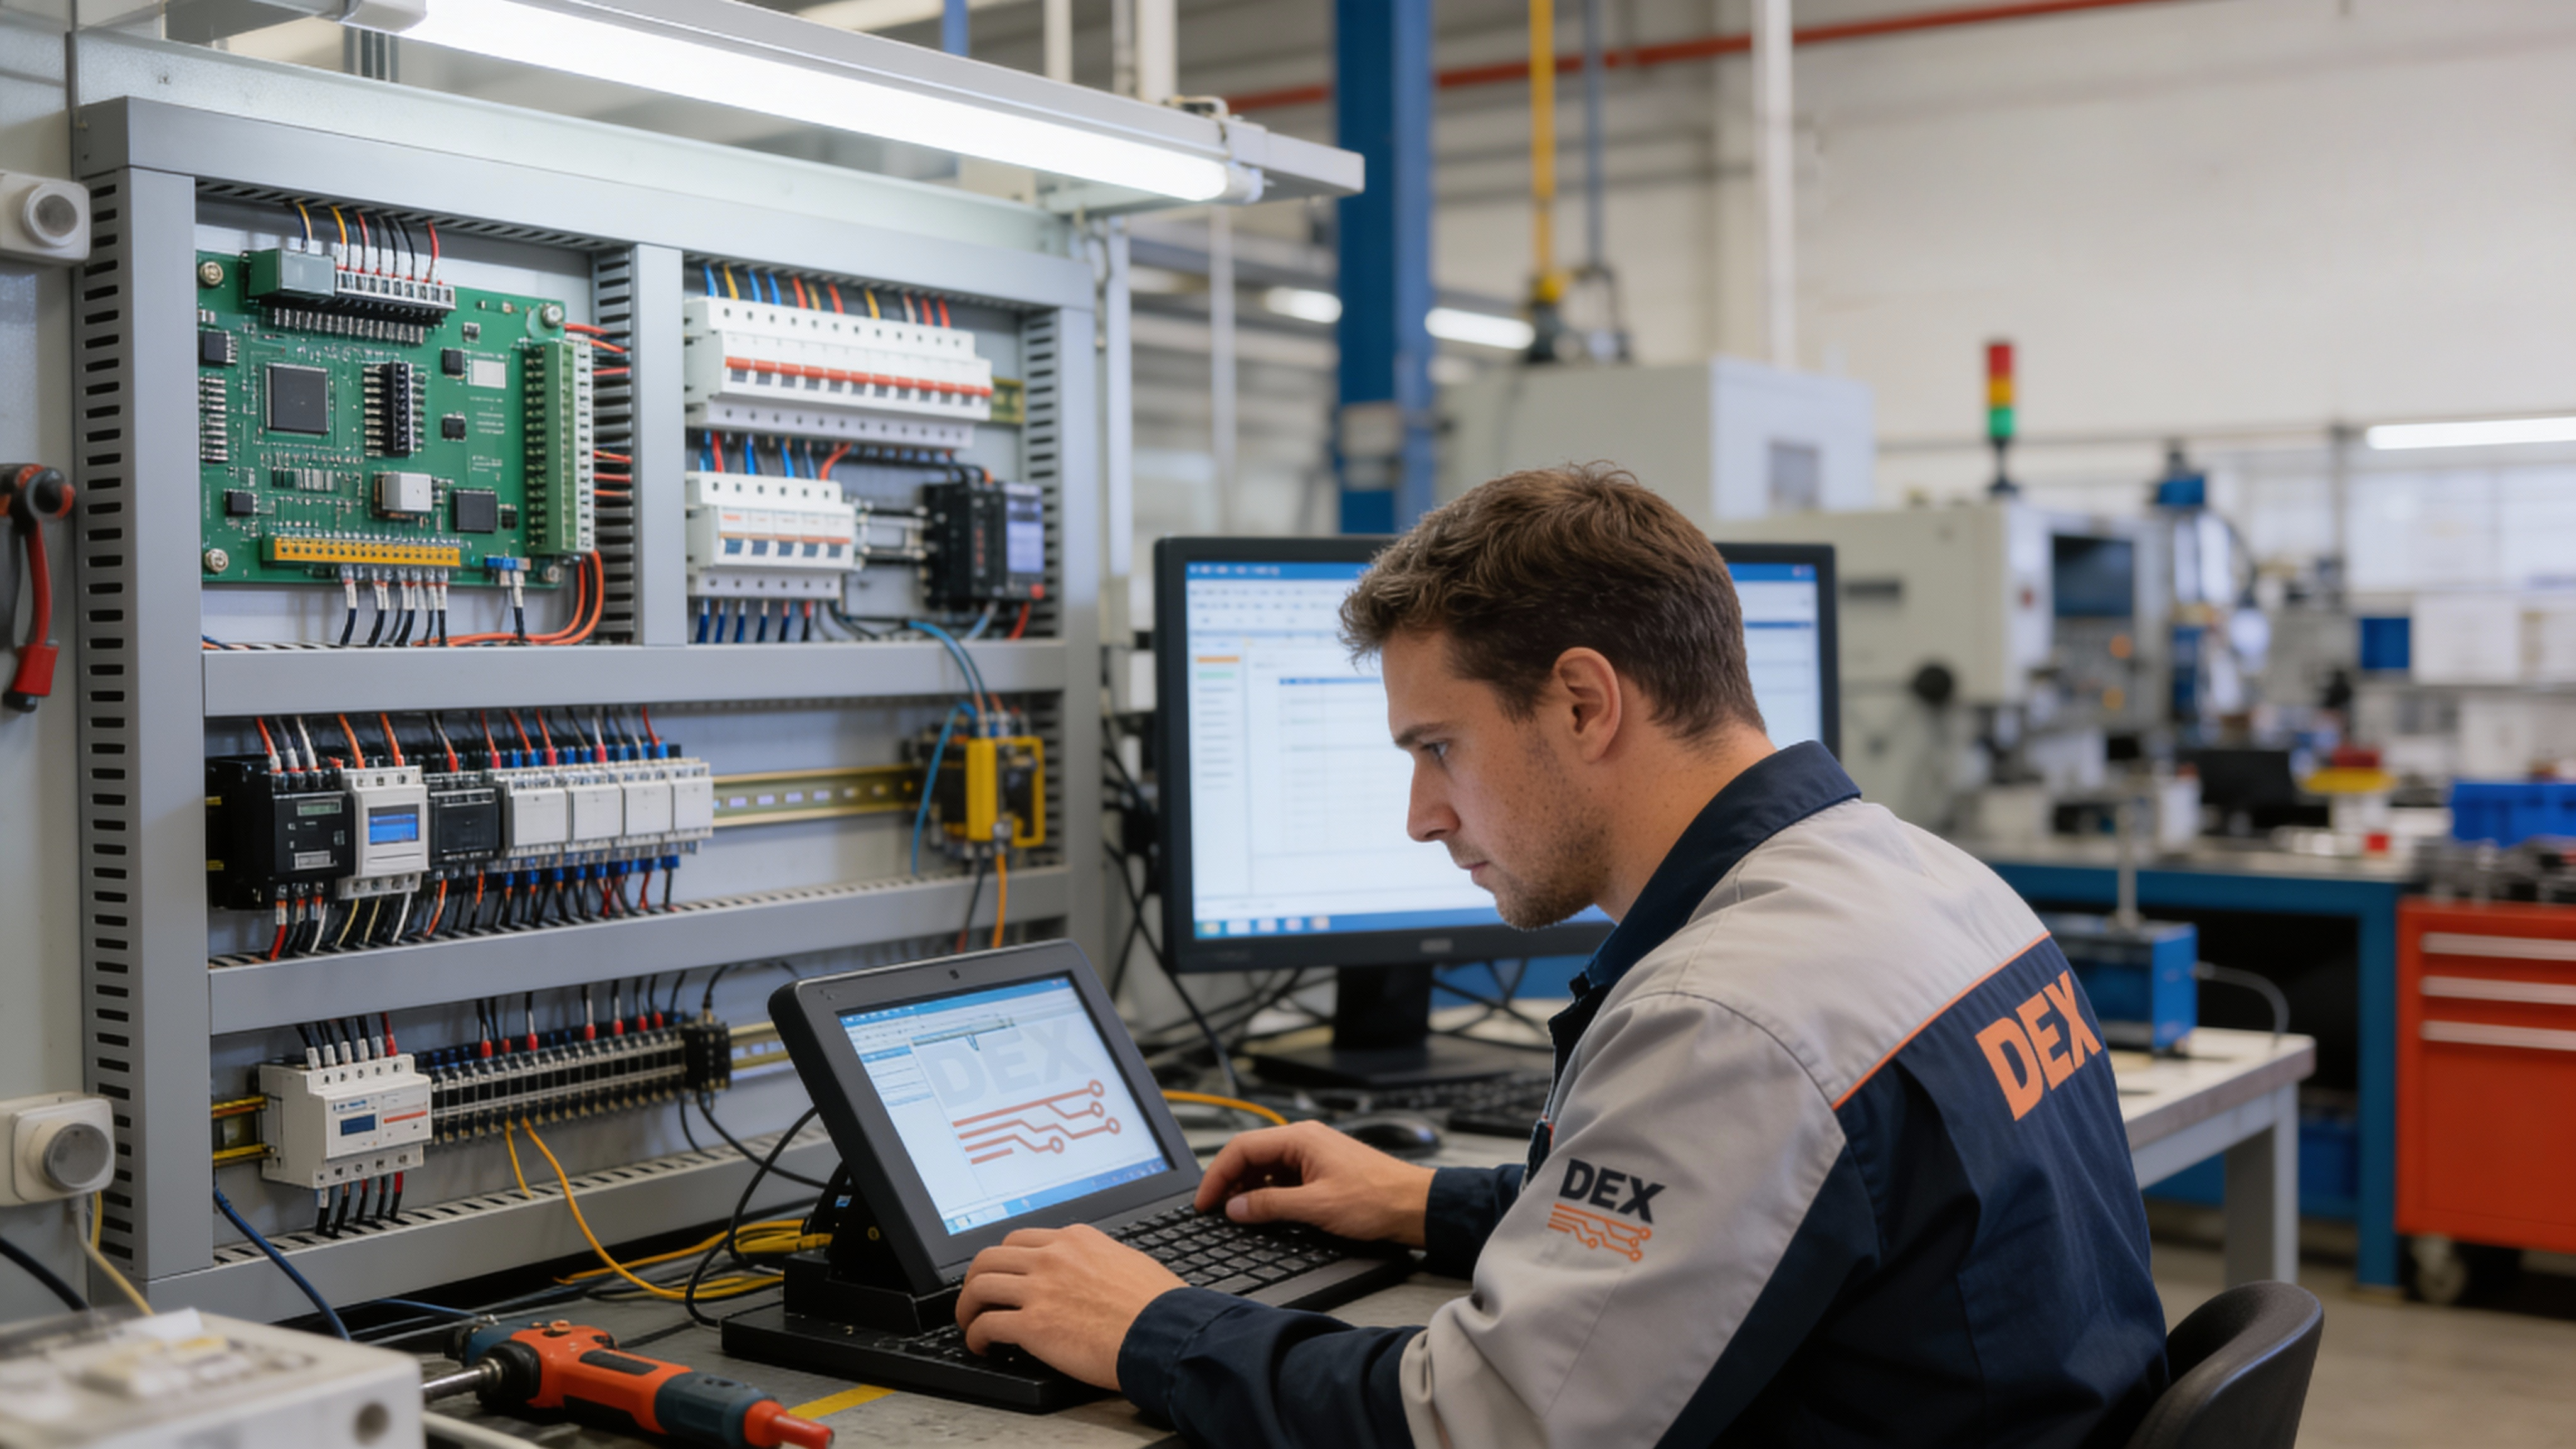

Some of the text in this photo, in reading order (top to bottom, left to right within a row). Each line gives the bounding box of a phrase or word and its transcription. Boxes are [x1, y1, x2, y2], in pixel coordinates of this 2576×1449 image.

[921, 1019, 1093, 1108] DEX
[1975, 970, 2102, 1121] DEX
[1559, 1158, 1665, 1224] DEX
